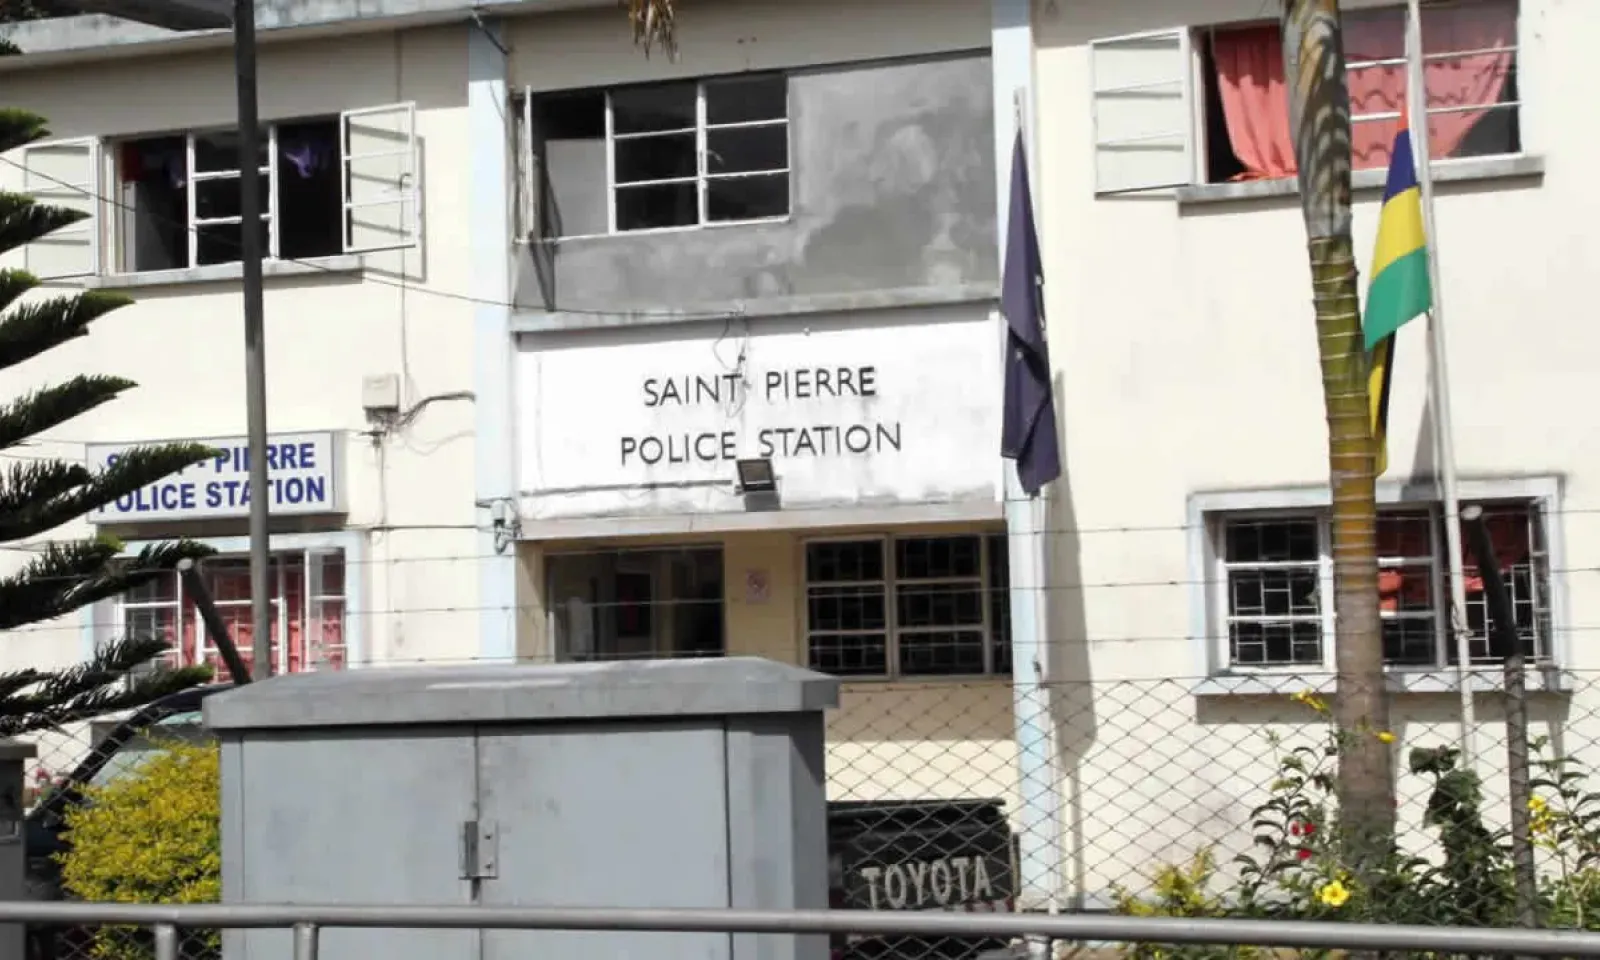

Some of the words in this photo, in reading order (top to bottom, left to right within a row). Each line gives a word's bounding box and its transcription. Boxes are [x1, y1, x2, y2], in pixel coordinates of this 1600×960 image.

[643, 373, 742, 407] SAINT
[765, 365, 877, 402] PIERRE
[620, 431, 737, 466] POLICE
[757, 421, 902, 458] STATION
[99, 483, 197, 513] OLICE
[861, 855, 992, 911] TOYOTA
